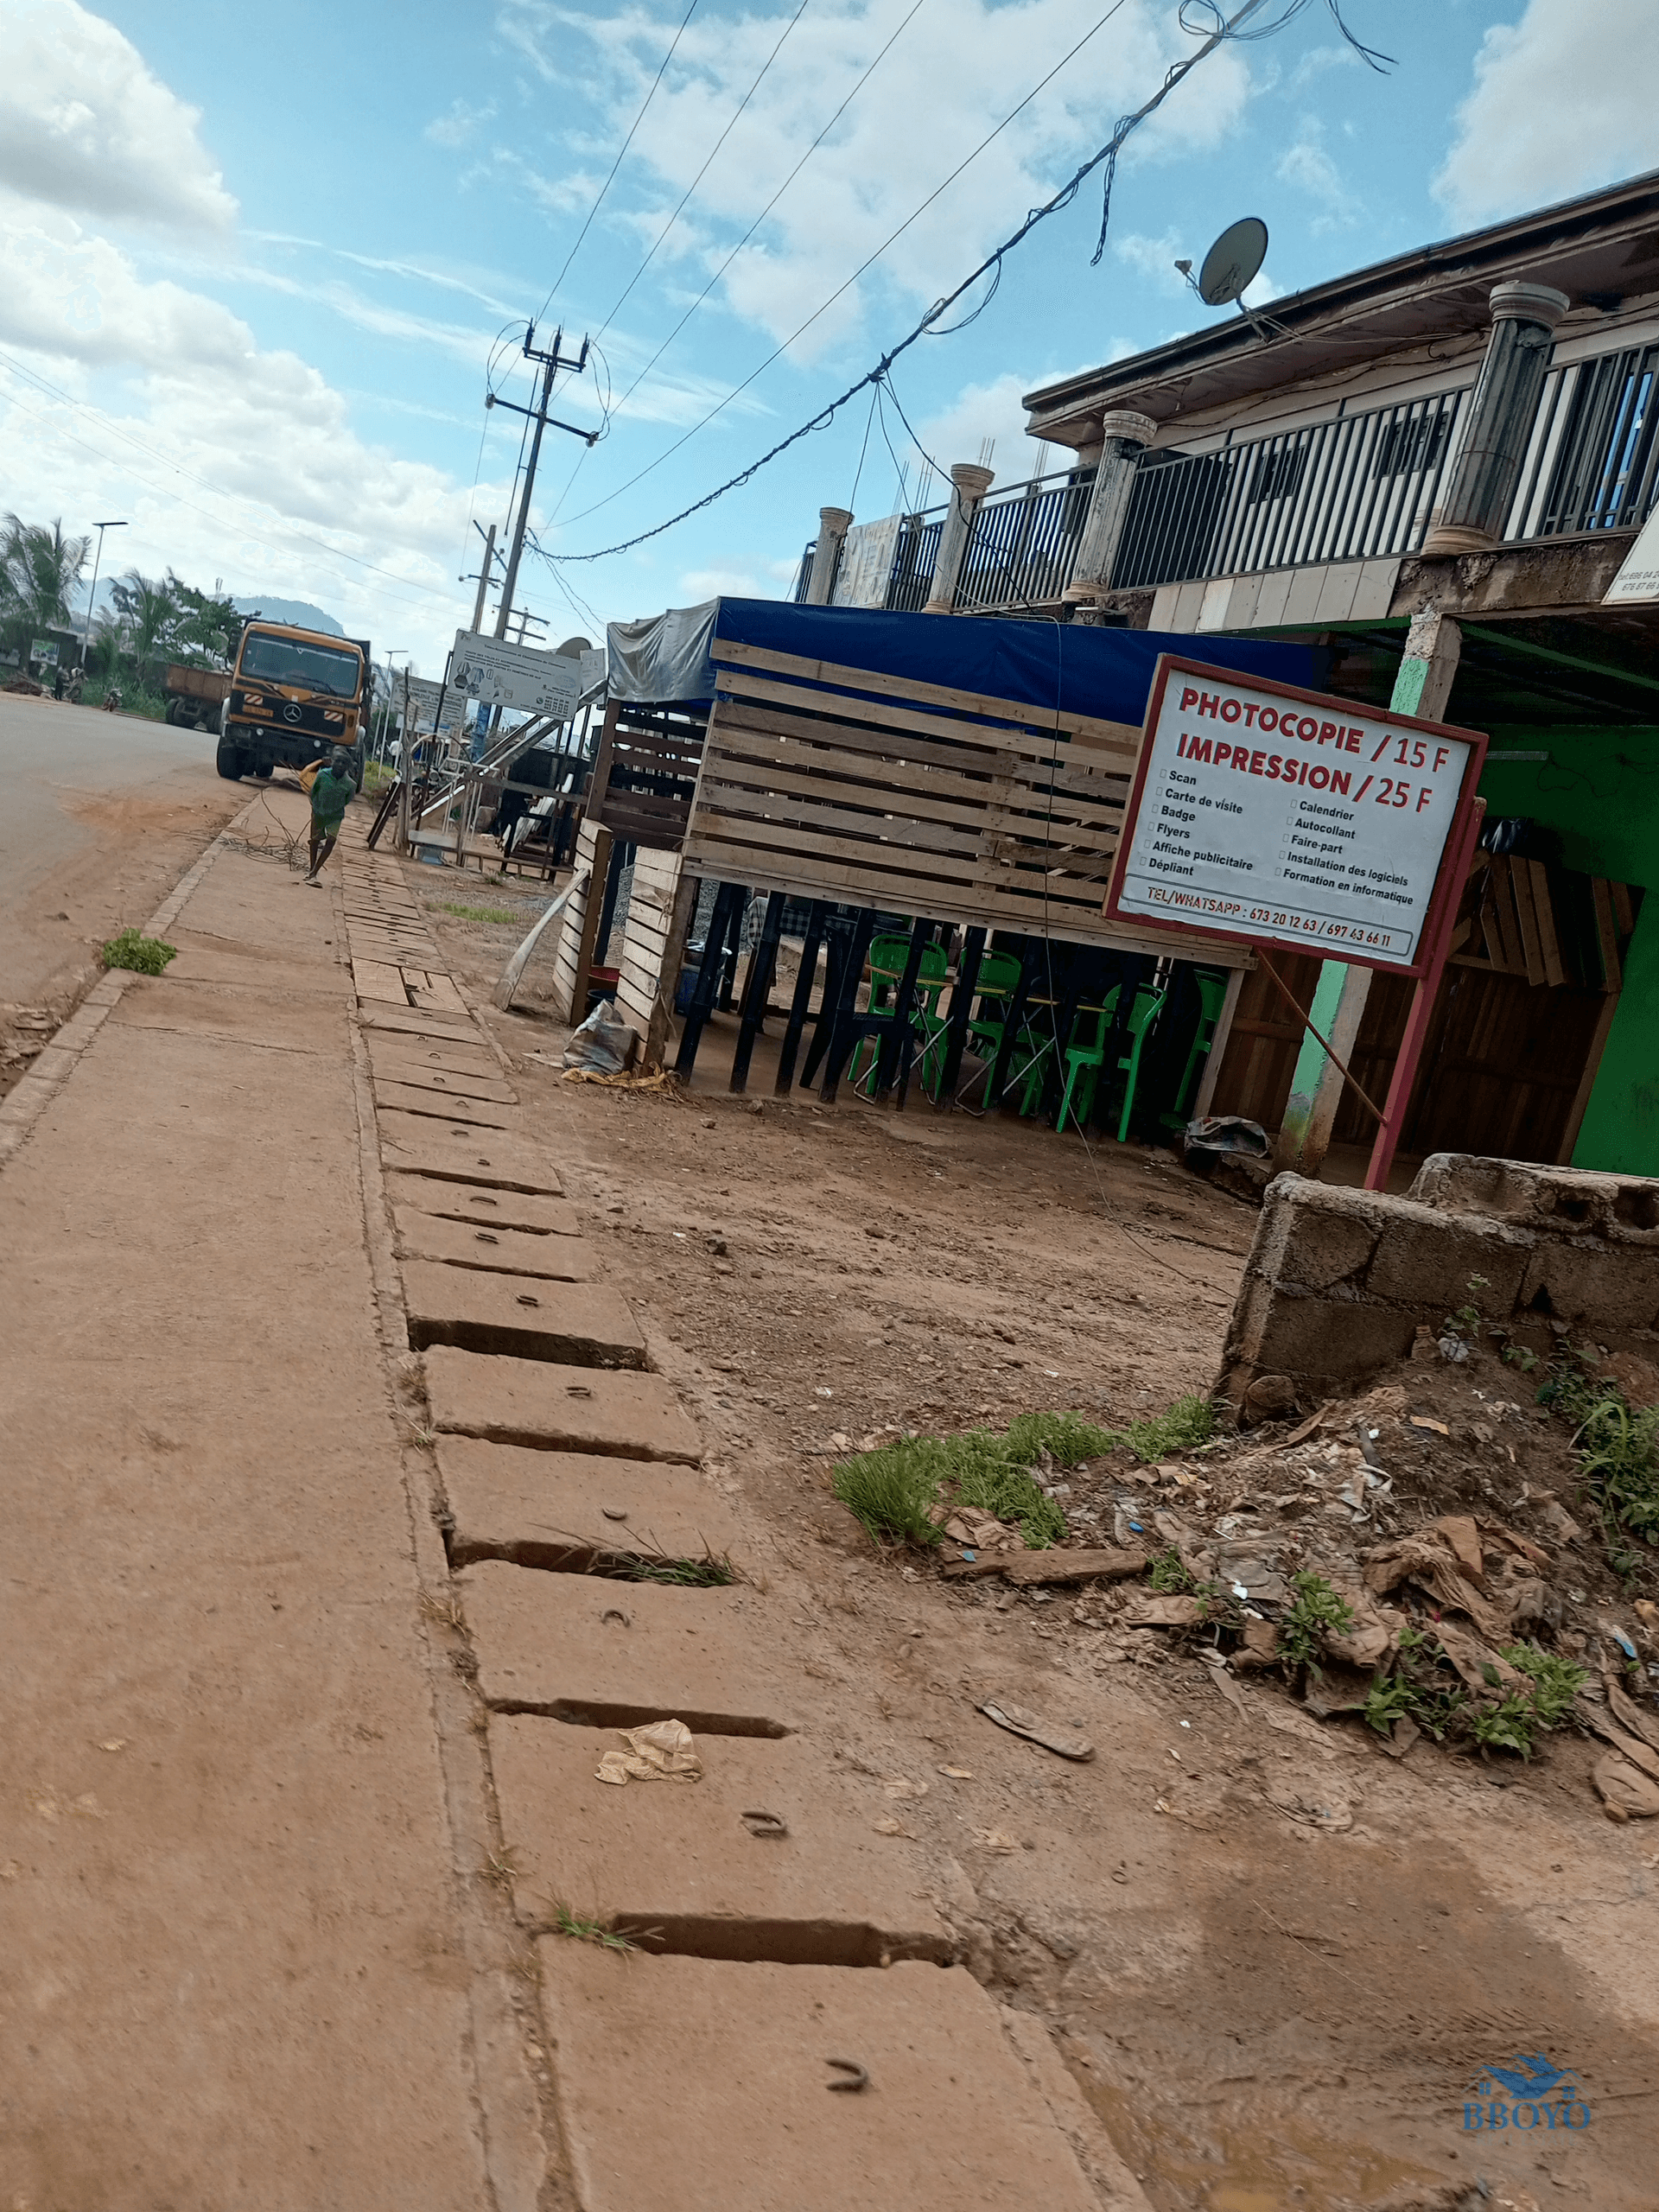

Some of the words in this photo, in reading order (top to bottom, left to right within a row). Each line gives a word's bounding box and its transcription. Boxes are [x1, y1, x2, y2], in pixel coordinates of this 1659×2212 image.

[1179, 688, 1363, 753] PHOTOCOPIE
[1370, 734, 1391, 761] /
[1394, 738, 1427, 767] 15
[1433, 747, 1449, 772] F
[1169, 771, 1196, 785] Scan
[1177, 734, 1351, 795] IMPRESSION
[1351, 775, 1374, 802] /
[1376, 779, 1409, 807] 25
[1416, 787, 1432, 812] F
[1166, 789, 1195, 803] Carte
[1199, 797, 1211, 806] de
[1216, 798, 1243, 813] visite
[1300, 801, 1354, 820] Calendrier
[1161, 805, 1195, 822] Badge
[1157, 823, 1190, 838] Flyers
[1295, 818, 1355, 839] Autocollant
[1292, 835, 1343, 854] Faire-part
[1149, 858, 1193, 875] Dépliant
[1153, 842, 1191, 856] Affiche
[1193, 852, 1253, 870] publicitaire
[1287, 852, 1344, 872] Installation
[1349, 866, 1365, 876] des
[1369, 869, 1408, 886] logiciels
[1283, 868, 1335, 887] Formation
[1352, 883, 1413, 905] informatique
[1148, 887, 1240, 915] TEL/WHATSAPP
[1250, 908, 1269, 921] 673
[1272, 912, 1286, 925] 20
[1290, 916, 1300, 928] 12
[1303, 919, 1316, 931] 63
[1318, 921, 1326, 934] /
[1327, 924, 1348, 937] 697
[1350, 929, 1363, 940] 43
[1366, 931, 1379, 944] 66
[1382, 935, 1390, 946] 11
